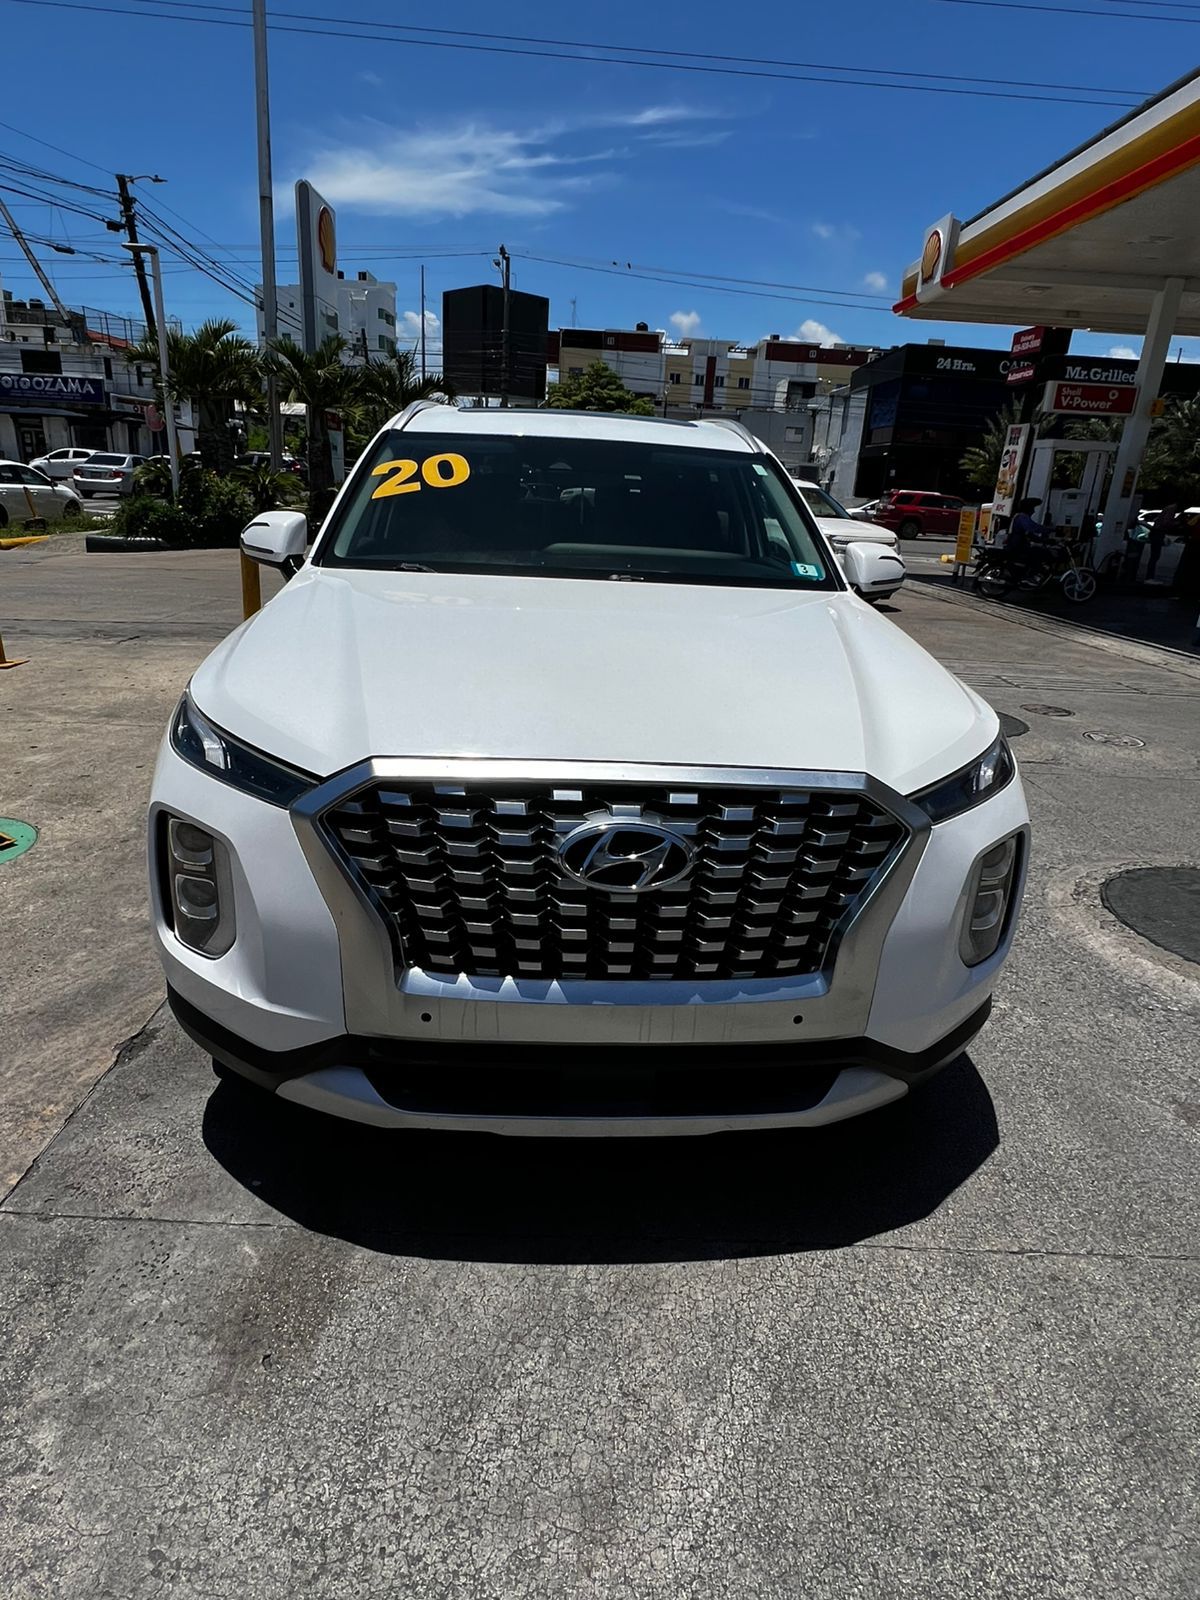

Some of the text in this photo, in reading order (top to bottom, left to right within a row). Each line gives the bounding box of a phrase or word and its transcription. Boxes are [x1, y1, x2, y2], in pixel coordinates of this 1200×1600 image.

[936, 358, 976, 372] 24 Hrs.
[1064, 366, 1089, 380] Mr.
[0, 375, 95, 394] OTO OZAMA
[1061, 387, 1082, 396] Shell
[1061, 396, 1112, 409] V-Power
[371, 453, 470, 500] 20
